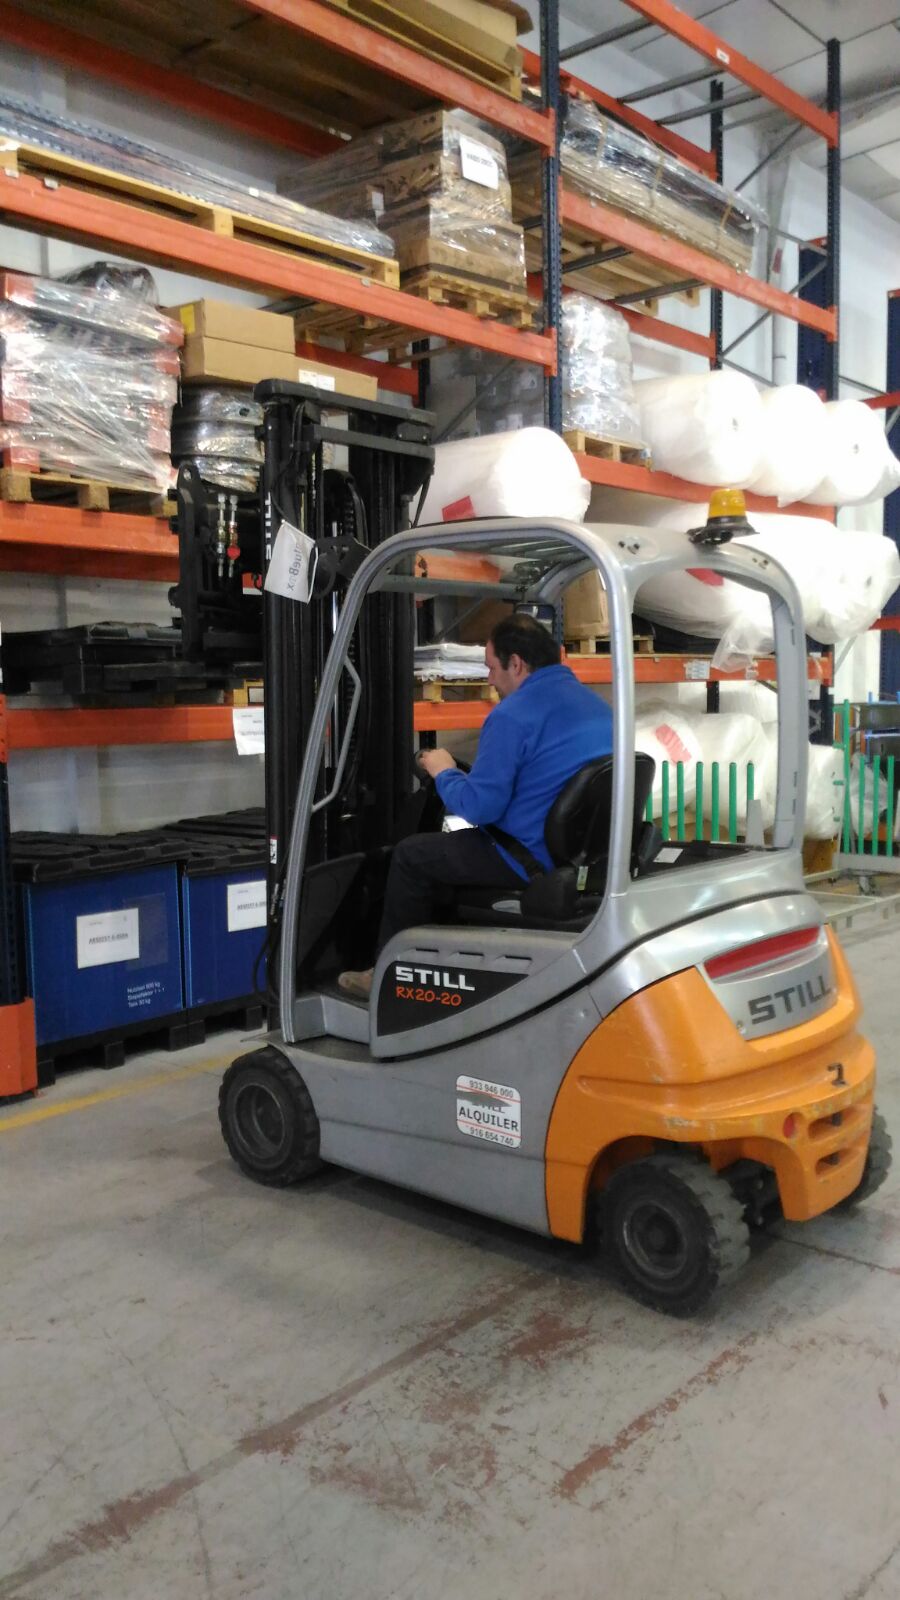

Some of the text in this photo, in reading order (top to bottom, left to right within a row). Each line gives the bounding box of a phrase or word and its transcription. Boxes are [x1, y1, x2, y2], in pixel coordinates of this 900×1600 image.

[395, 966, 476, 991] STILL
[395, 986, 462, 1006] RX20-20
[747, 975, 832, 1025] STILL
[459, 1106, 519, 1132] ALQUILER
